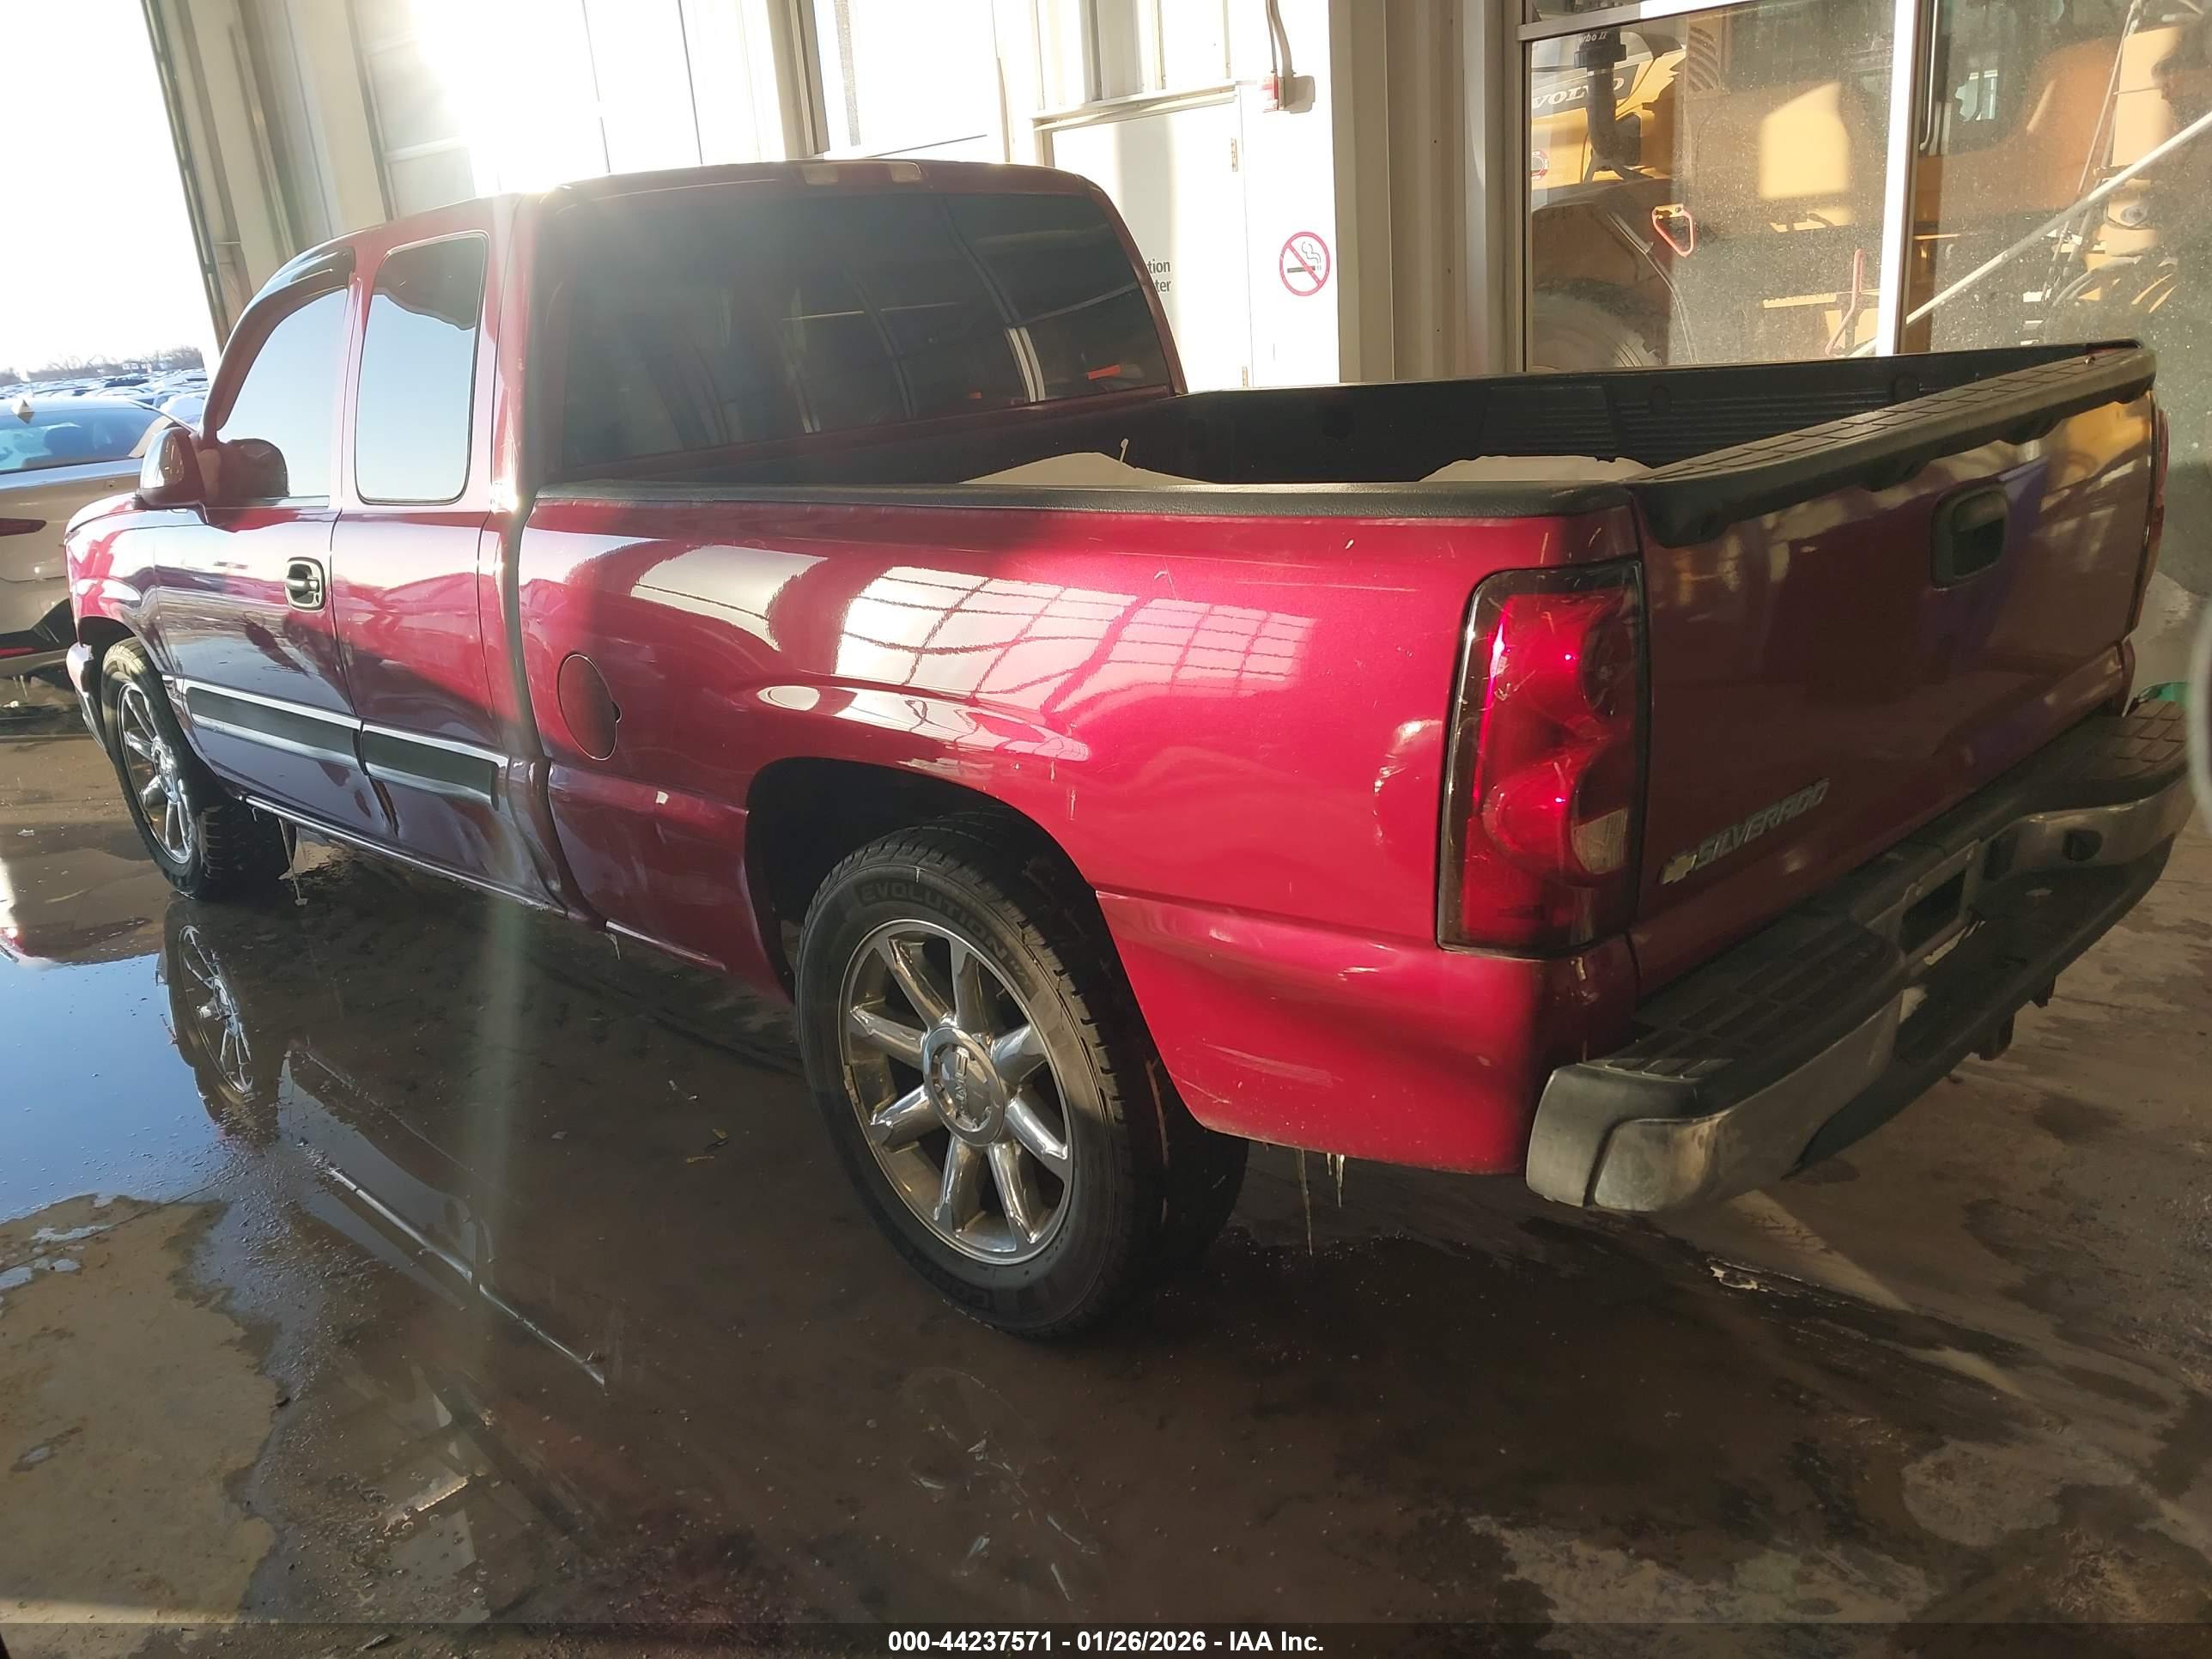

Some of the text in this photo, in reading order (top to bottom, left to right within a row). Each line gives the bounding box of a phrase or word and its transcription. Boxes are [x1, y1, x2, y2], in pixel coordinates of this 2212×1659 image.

[1531, 77, 1625, 110] VOLO
[1147, 258, 1170, 274] tion
[1154, 279, 1172, 293] ter
[1695, 776, 1831, 871] SILVERADO
[861, 880, 1008, 960] EVOLUTION
